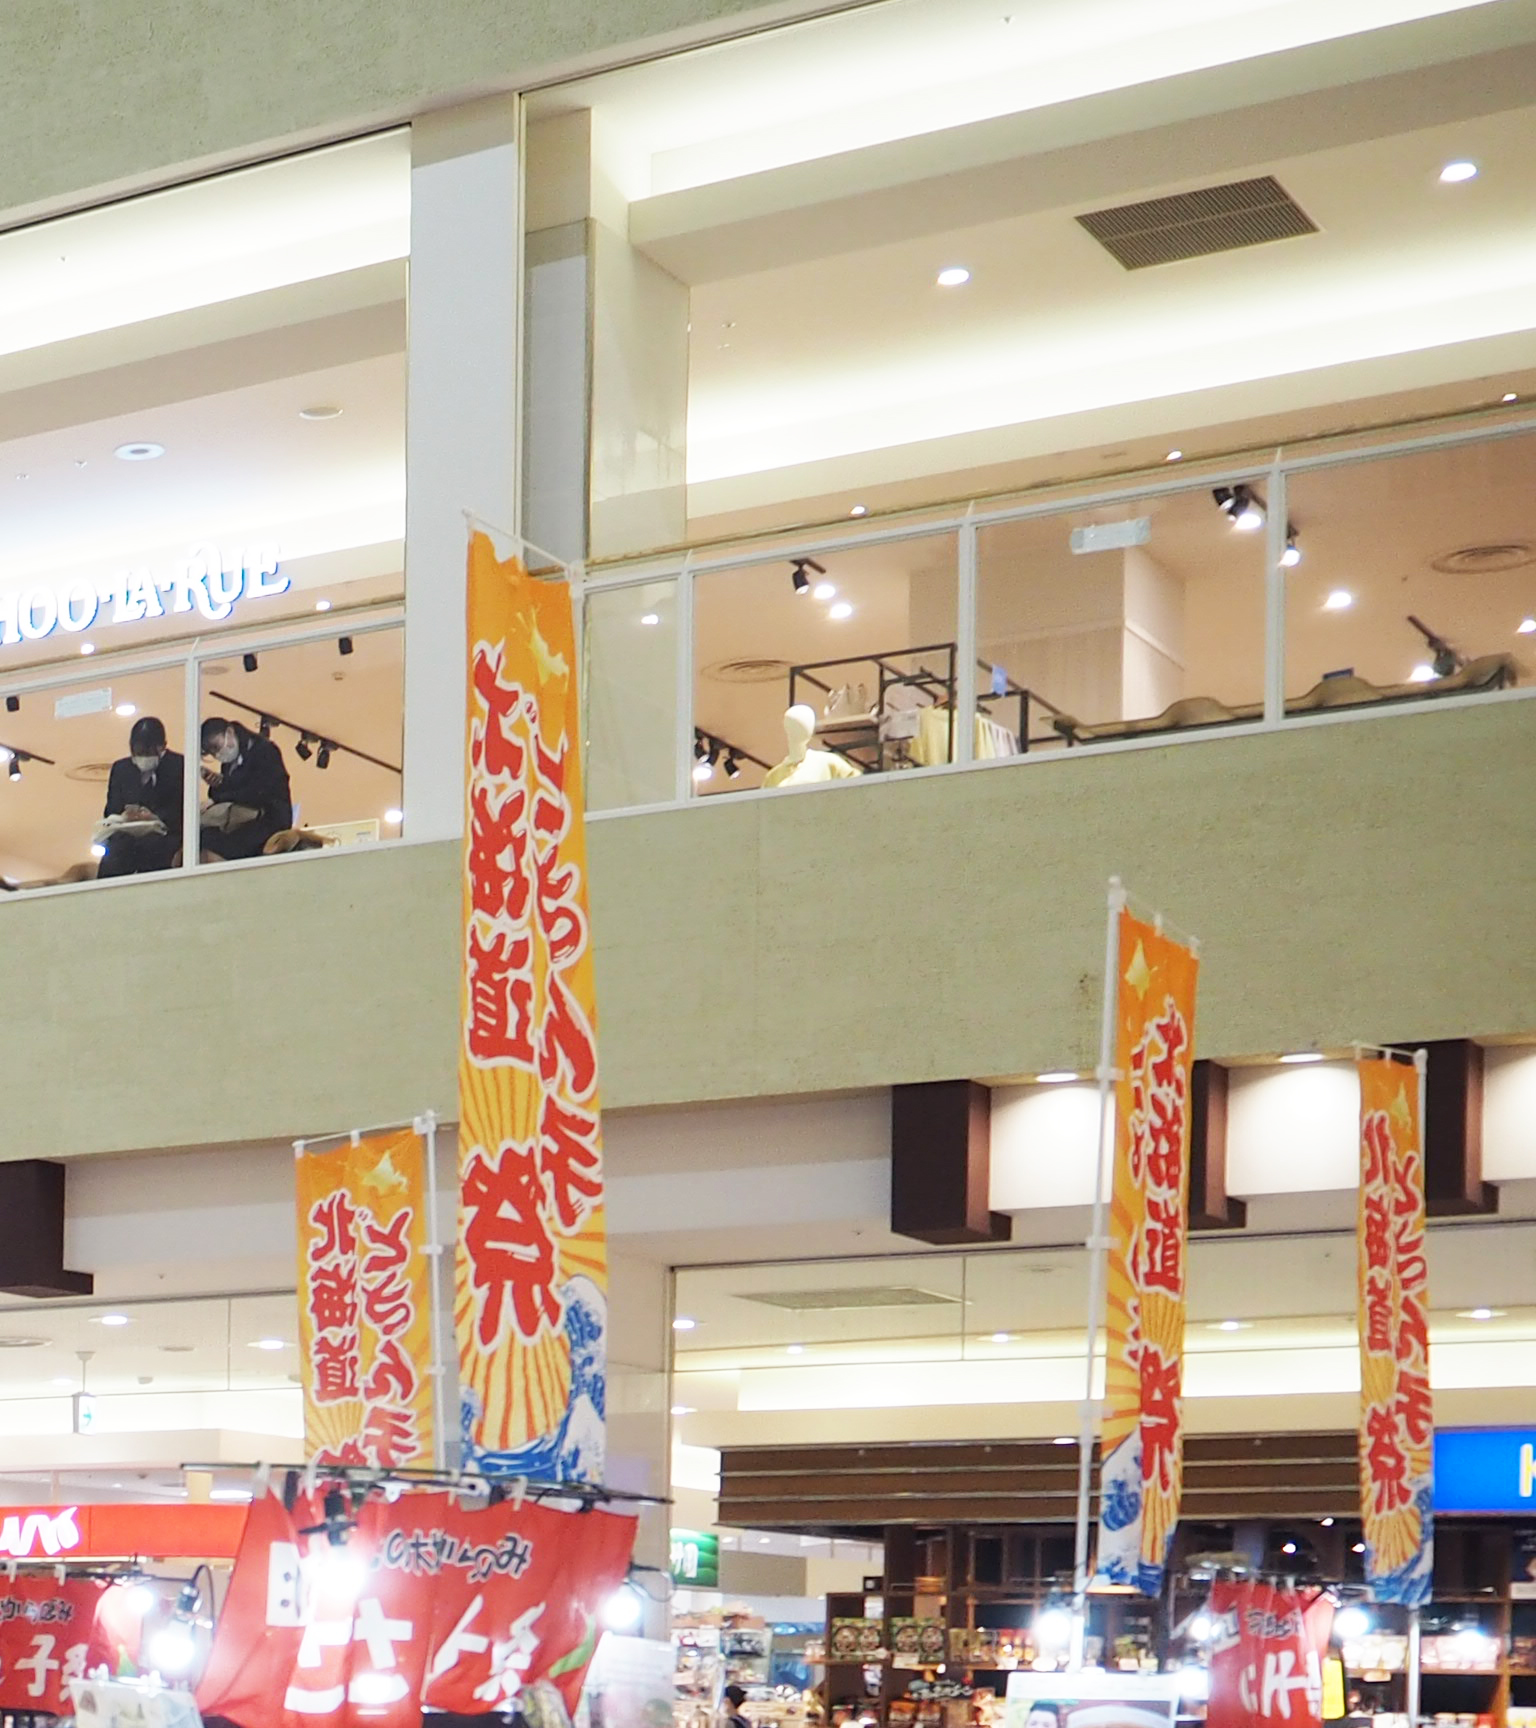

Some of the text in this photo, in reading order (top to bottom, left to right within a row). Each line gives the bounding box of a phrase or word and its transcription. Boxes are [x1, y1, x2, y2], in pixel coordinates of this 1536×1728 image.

[468, 640, 535, 1068] 北海道
[1142, 996, 1187, 1296] 北海道
[306, 1188, 361, 1406] 北海道
